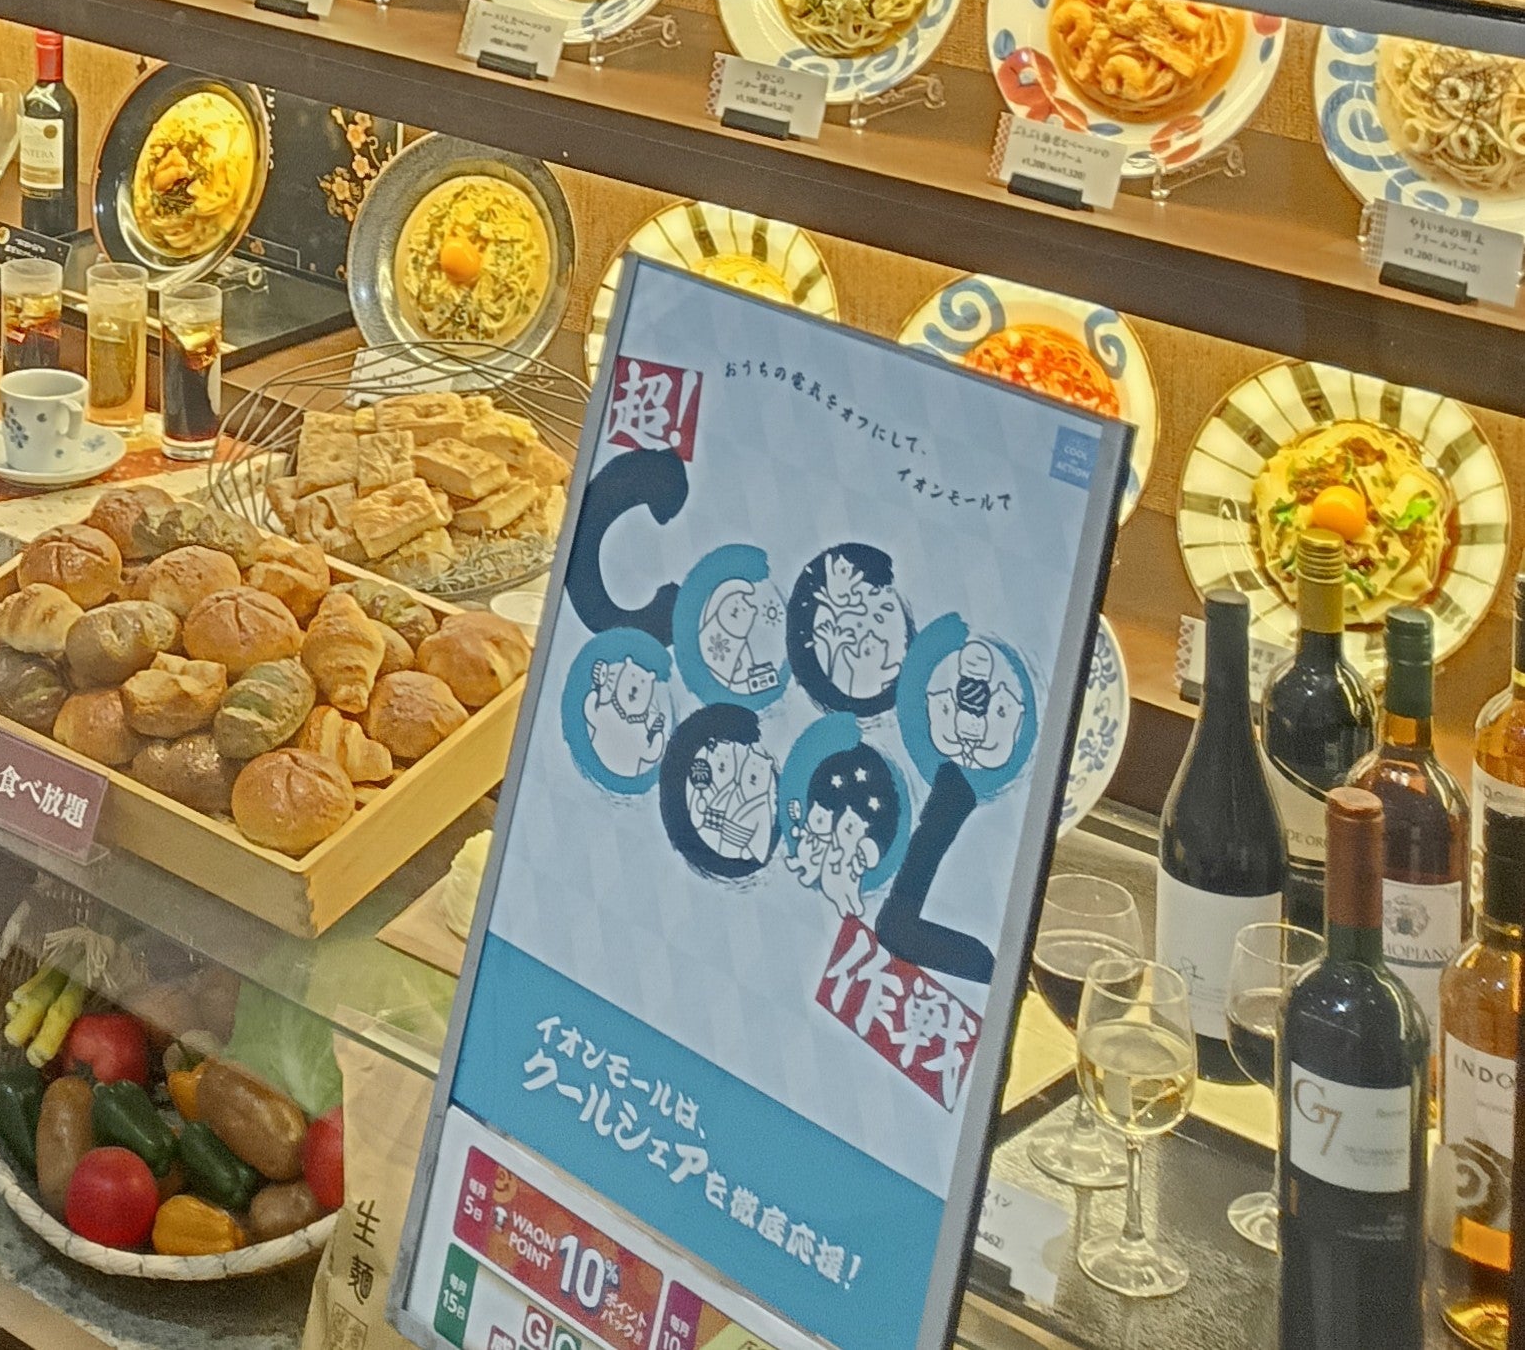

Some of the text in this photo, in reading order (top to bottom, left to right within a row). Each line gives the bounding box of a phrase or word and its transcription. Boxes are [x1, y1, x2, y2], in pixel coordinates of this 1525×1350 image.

[725, 360, 927, 455] おうちの電気をオフにして、
[897, 467, 1012, 511] イオンモールで
[827, 928, 978, 1113] 作戦
[535, 1014, 707, 1139] イオンモールは、
[463, 1195, 483, 1222] 5日
[347, 1199, 381, 1306] 生麺
[508, 1233, 553, 1271] POINT
[512, 1210, 558, 1253] WAON
[441, 1289, 466, 1321] 15日
[604, 1292, 647, 1329] ポイント
